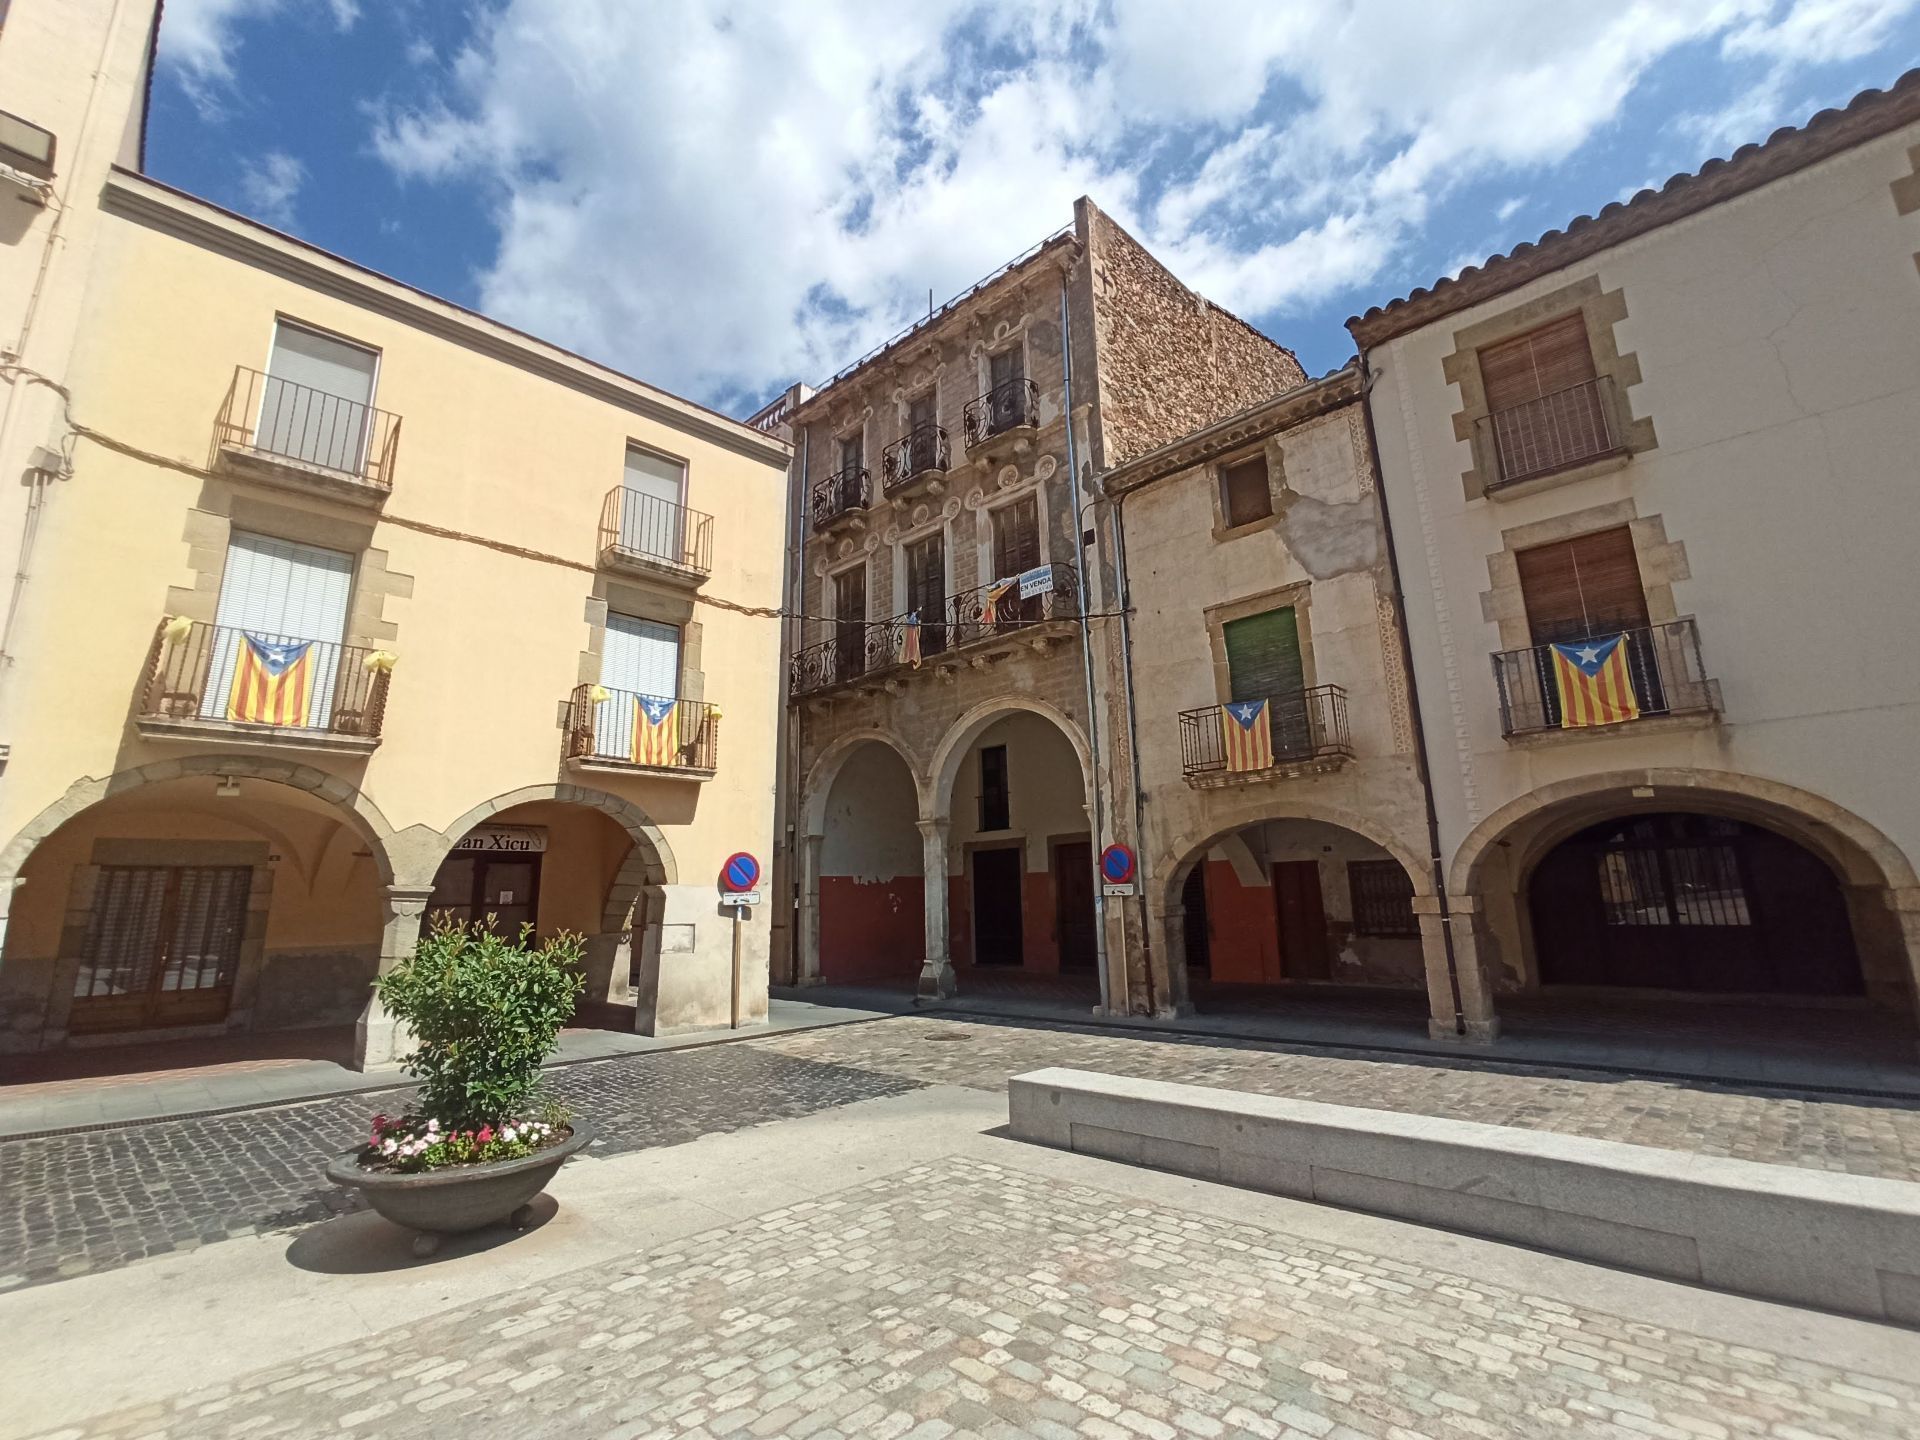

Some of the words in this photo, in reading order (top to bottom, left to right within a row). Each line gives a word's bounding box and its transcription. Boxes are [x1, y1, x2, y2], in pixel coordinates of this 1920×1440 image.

[1020, 584, 1029, 592] EN
[1029, 577, 1052, 588] VENDA
[452, 837, 484, 849] an
[487, 834, 530, 850] Xicu
